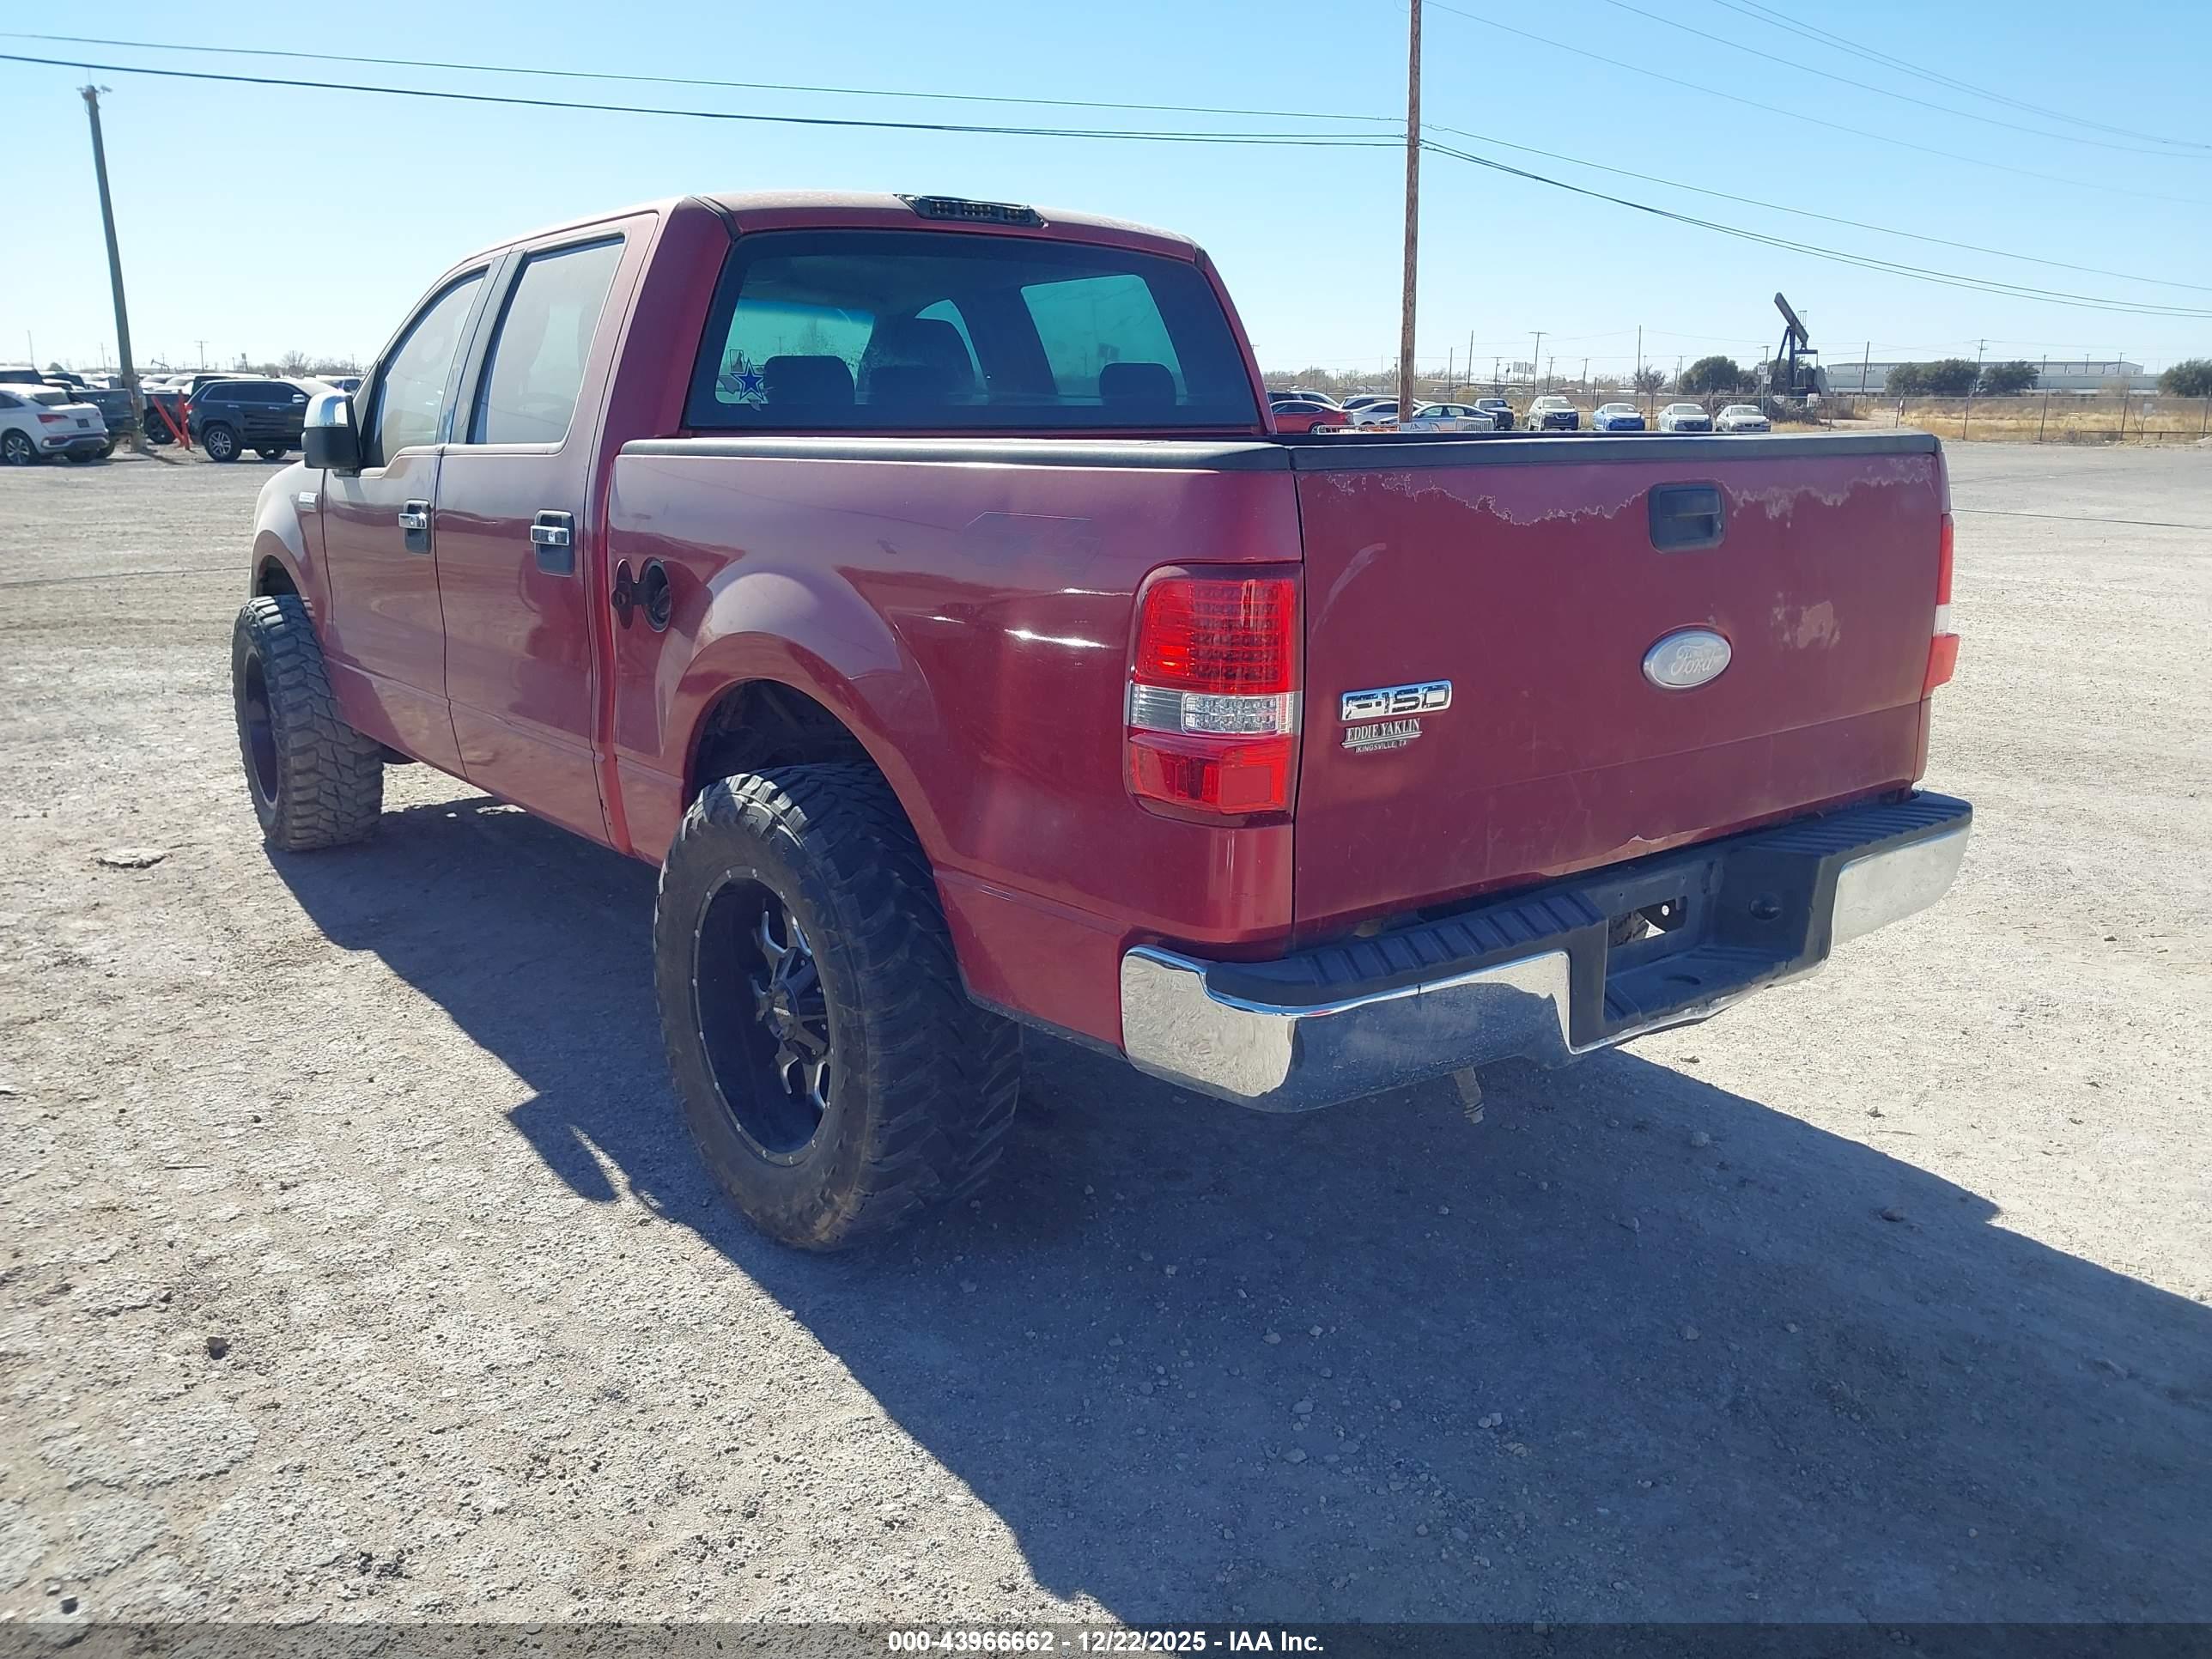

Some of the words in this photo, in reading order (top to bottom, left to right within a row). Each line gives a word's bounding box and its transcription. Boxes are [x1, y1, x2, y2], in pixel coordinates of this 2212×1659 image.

[1670, 645, 1716, 677] Ford
[1343, 682, 1451, 720] F-150
[1346, 724, 1379, 742] EDDIE
[1379, 718, 1421, 736] YAKLIN
